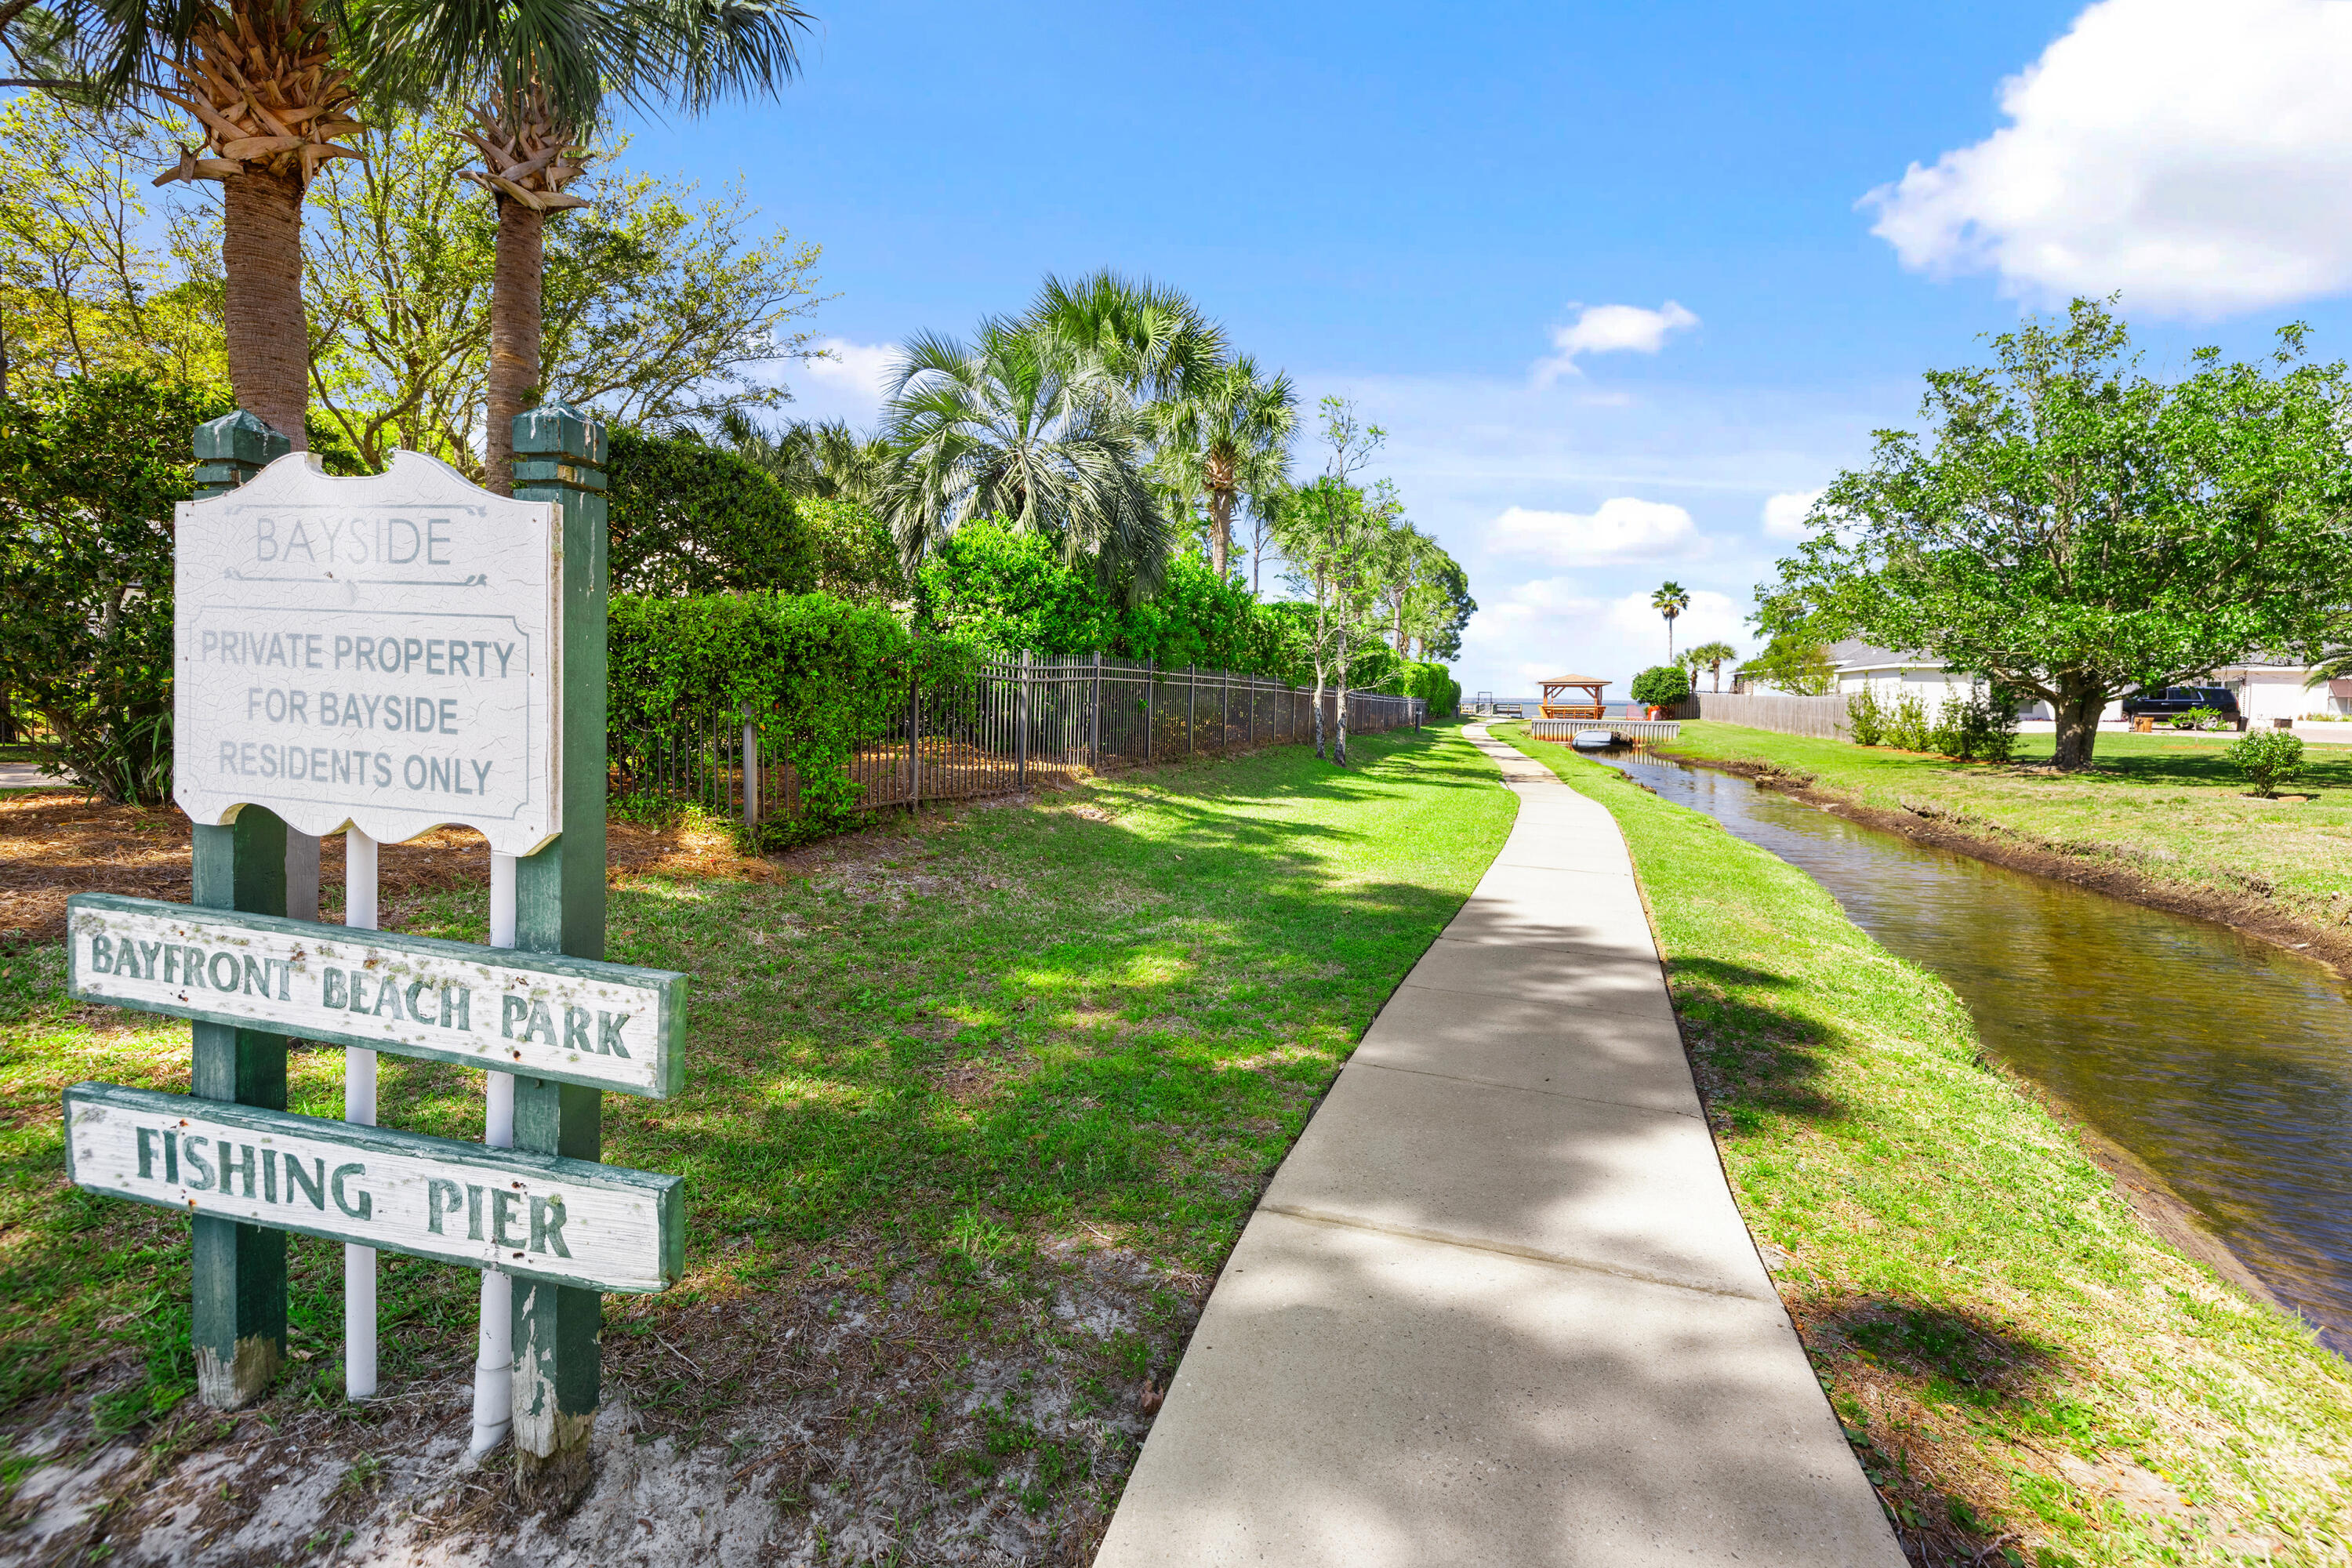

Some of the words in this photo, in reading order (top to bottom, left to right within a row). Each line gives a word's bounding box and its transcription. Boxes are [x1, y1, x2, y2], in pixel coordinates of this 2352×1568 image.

[256, 517, 452, 565] BAYSIDE
[201, 630, 324, 669] PRIVATE
[334, 634, 516, 678] PROPERTY
[247, 687, 309, 724] FOR
[319, 691, 458, 735] BAYSIDE
[220, 741, 392, 788] RESIDENTS
[403, 753, 493, 796] ONLY
[91, 934, 296, 1002] BAYFRONT
[322, 966, 470, 1031] BEACH
[501, 994, 632, 1058] PARK
[136, 1126, 372, 1221] FISHING
[426, 1177, 572, 1258] PIER
